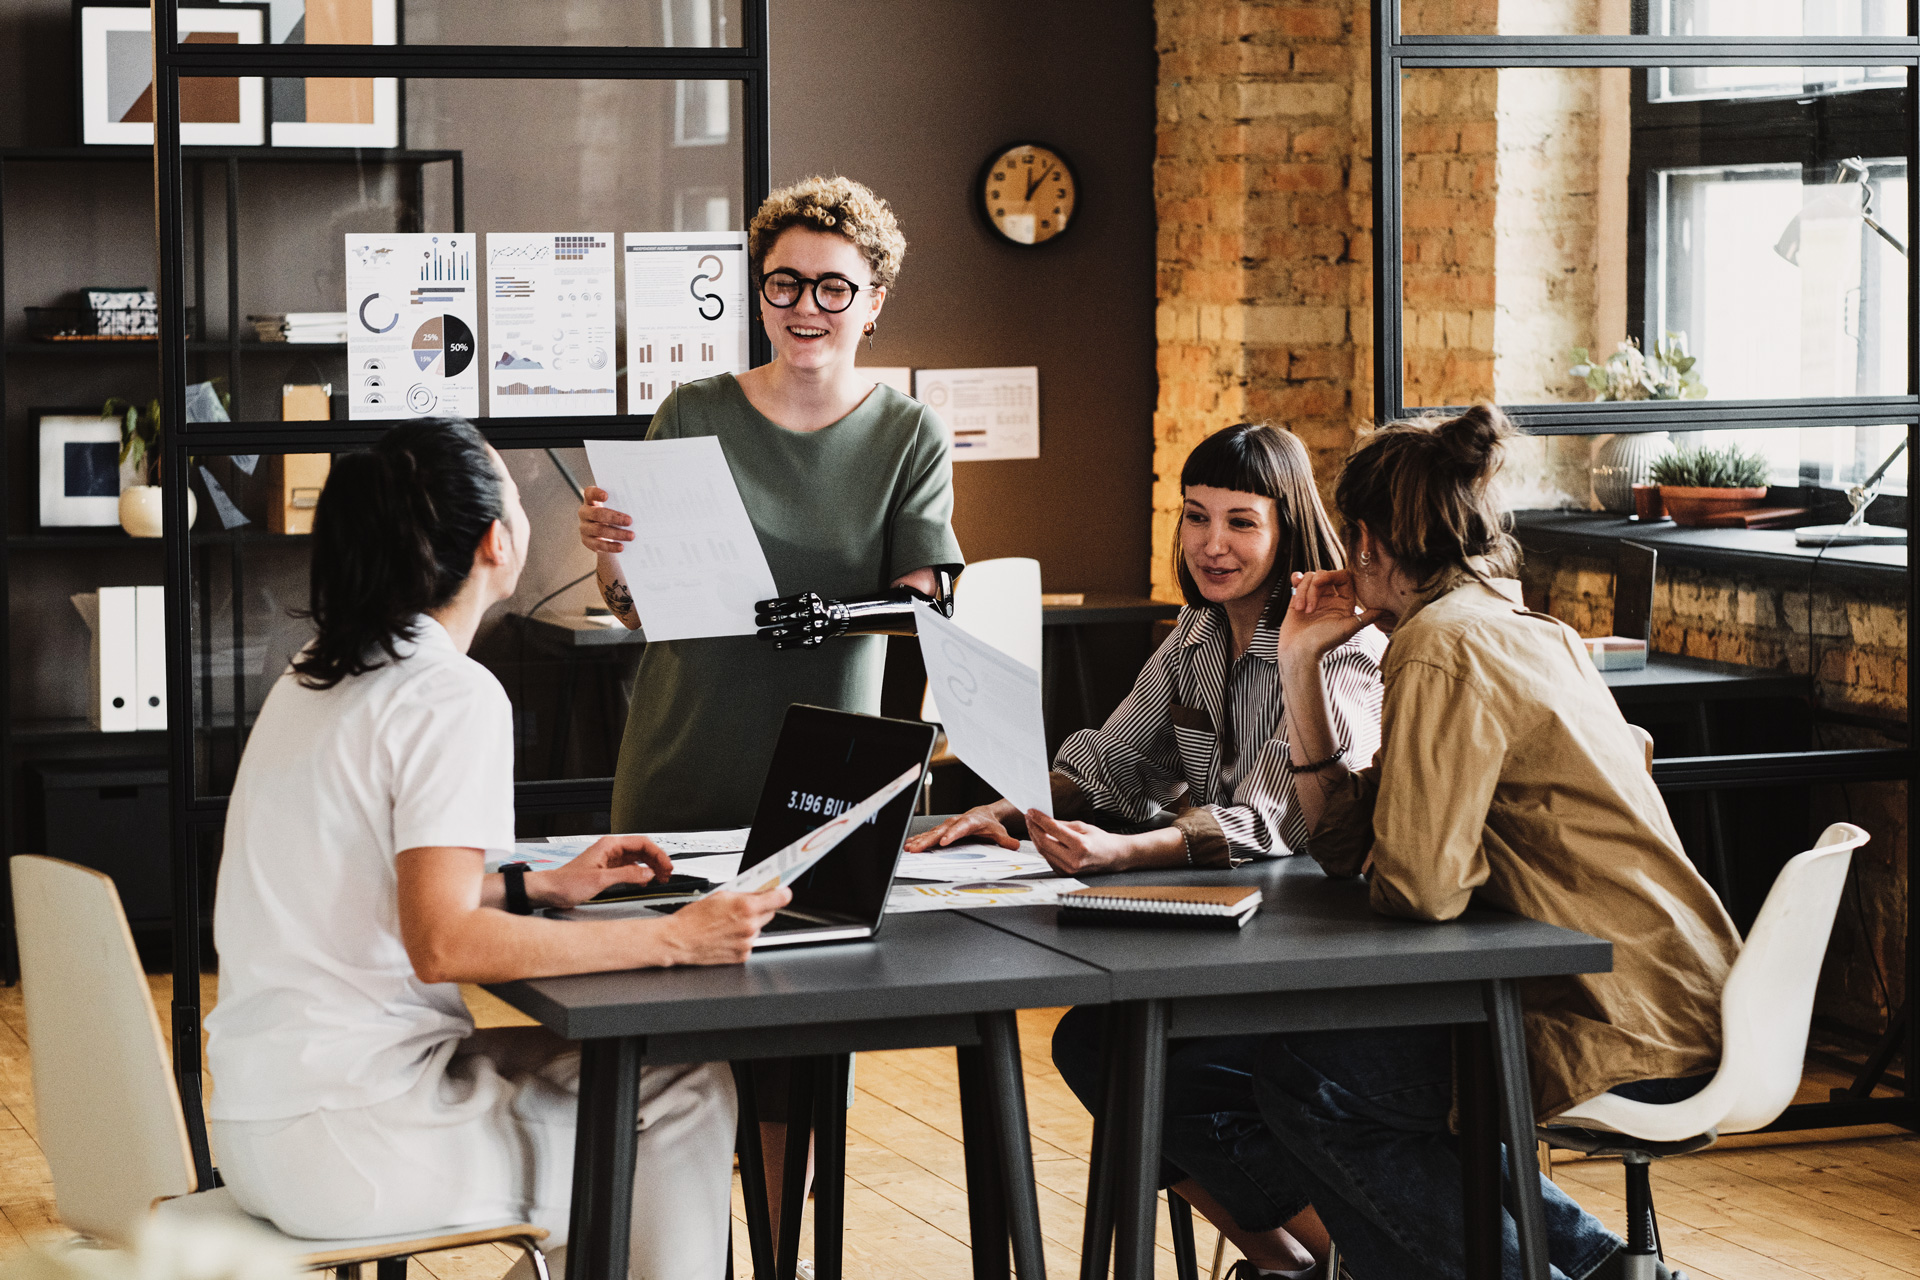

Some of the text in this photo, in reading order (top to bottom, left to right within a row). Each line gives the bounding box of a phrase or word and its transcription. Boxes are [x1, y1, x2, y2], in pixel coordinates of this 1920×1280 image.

[423, 333, 439, 342] 25%
[450, 342, 469, 352] 50%
[787, 790, 823, 814] 3.196
